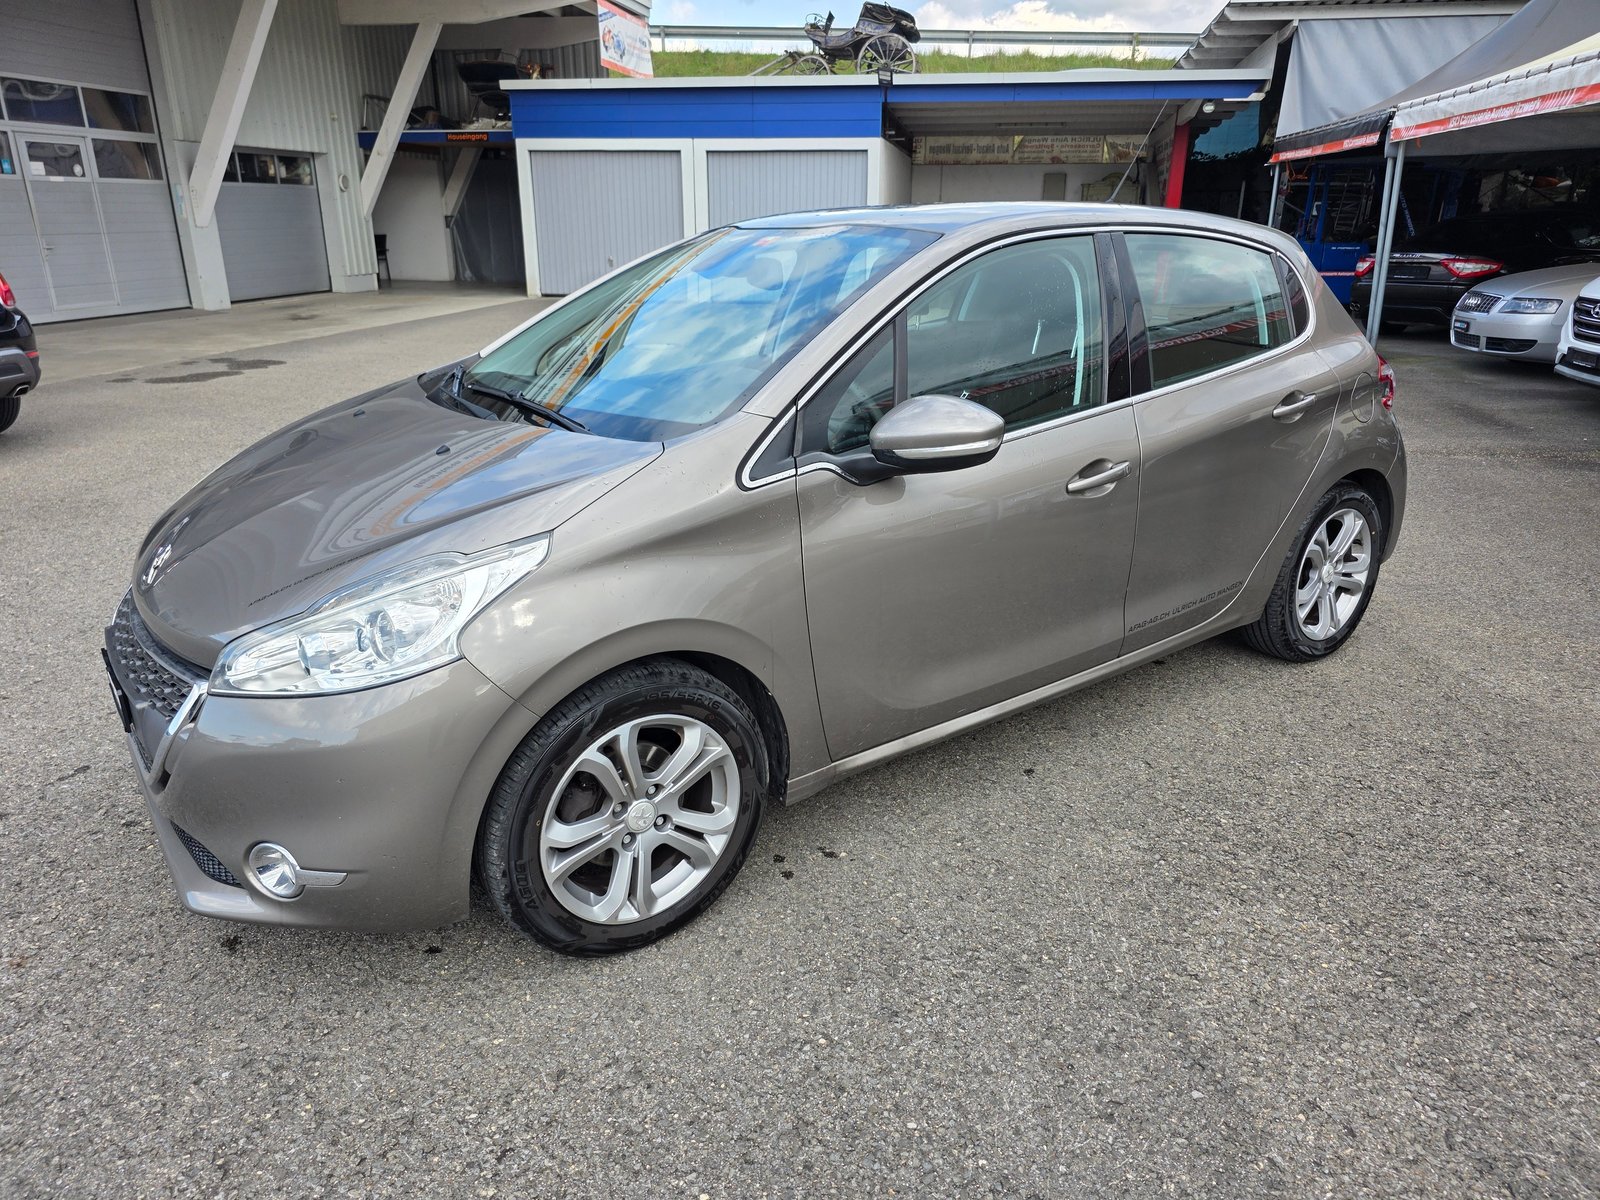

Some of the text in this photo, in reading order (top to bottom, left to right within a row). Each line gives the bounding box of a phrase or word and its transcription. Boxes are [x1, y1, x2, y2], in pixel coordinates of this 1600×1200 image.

[447, 133, 488, 141] Hauseingang
[1128, 580, 1244, 633] AFAG-AG.CH ULRICH AUTO WANGEN
